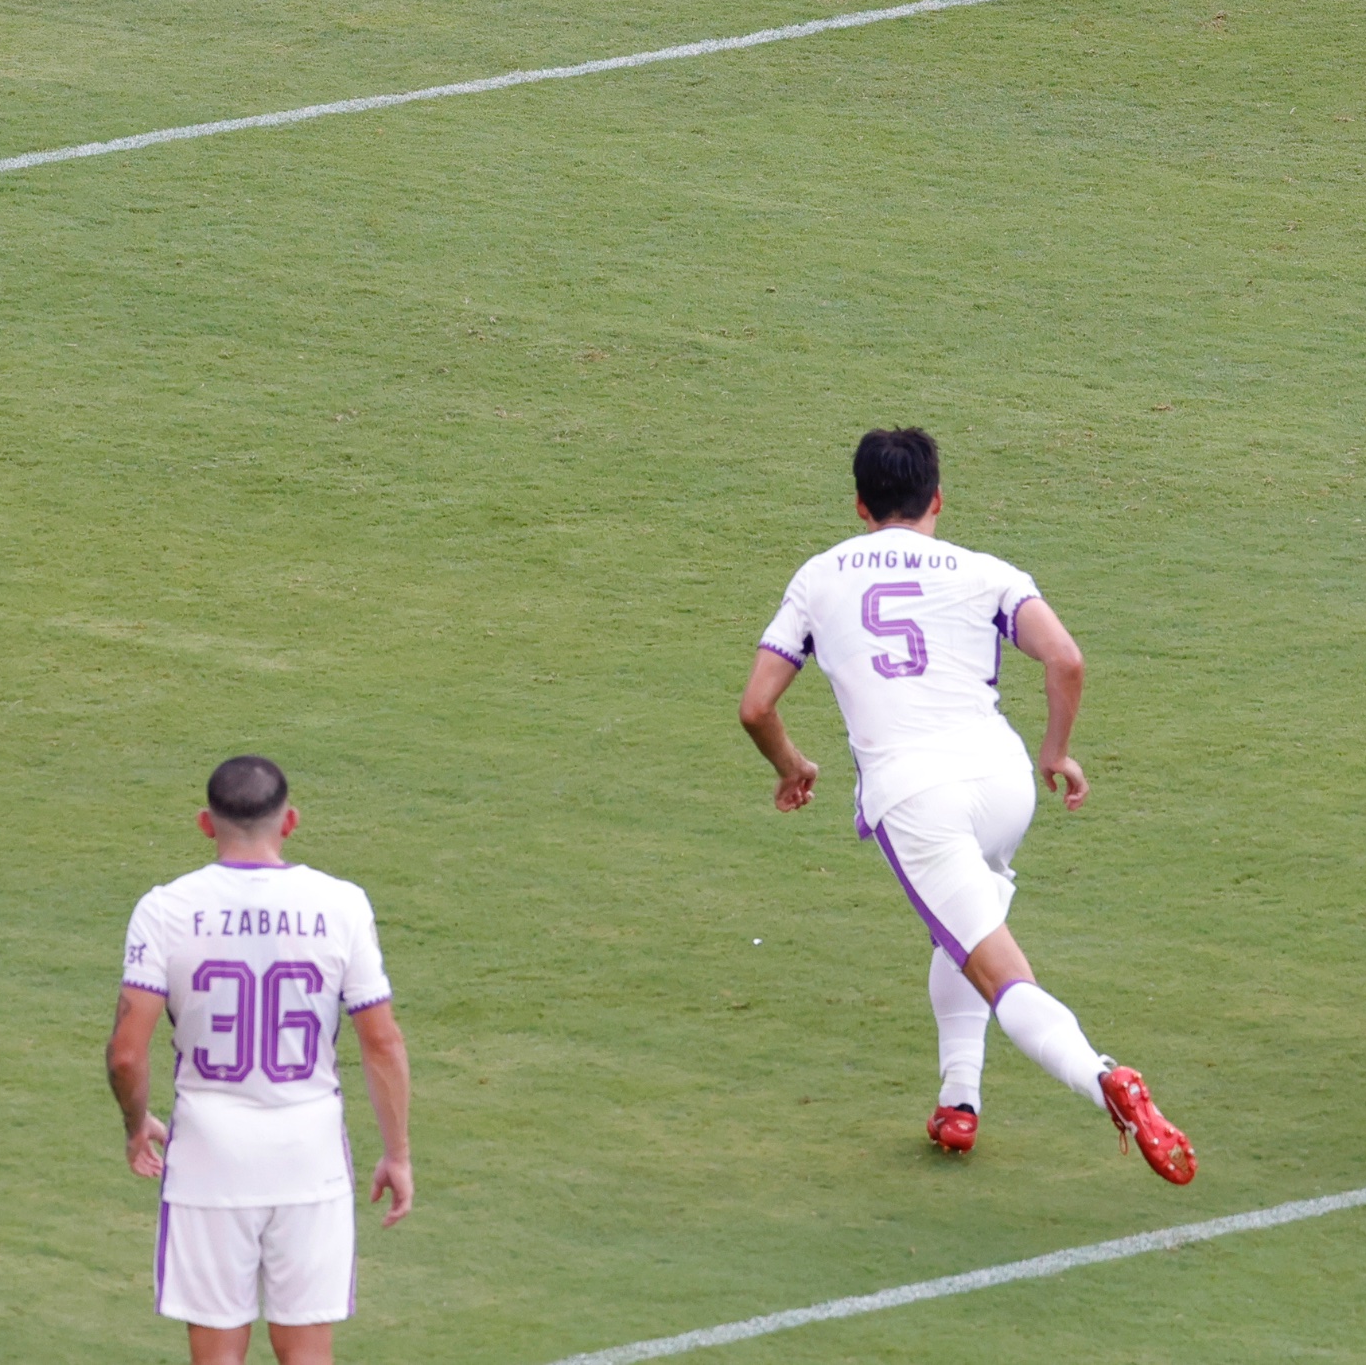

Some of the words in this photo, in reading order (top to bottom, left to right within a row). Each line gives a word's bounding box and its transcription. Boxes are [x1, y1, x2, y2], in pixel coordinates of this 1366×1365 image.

[837, 550, 957, 572] YONGWUO
[861, 581, 929, 680] 5
[192, 959, 324, 1084] 36
